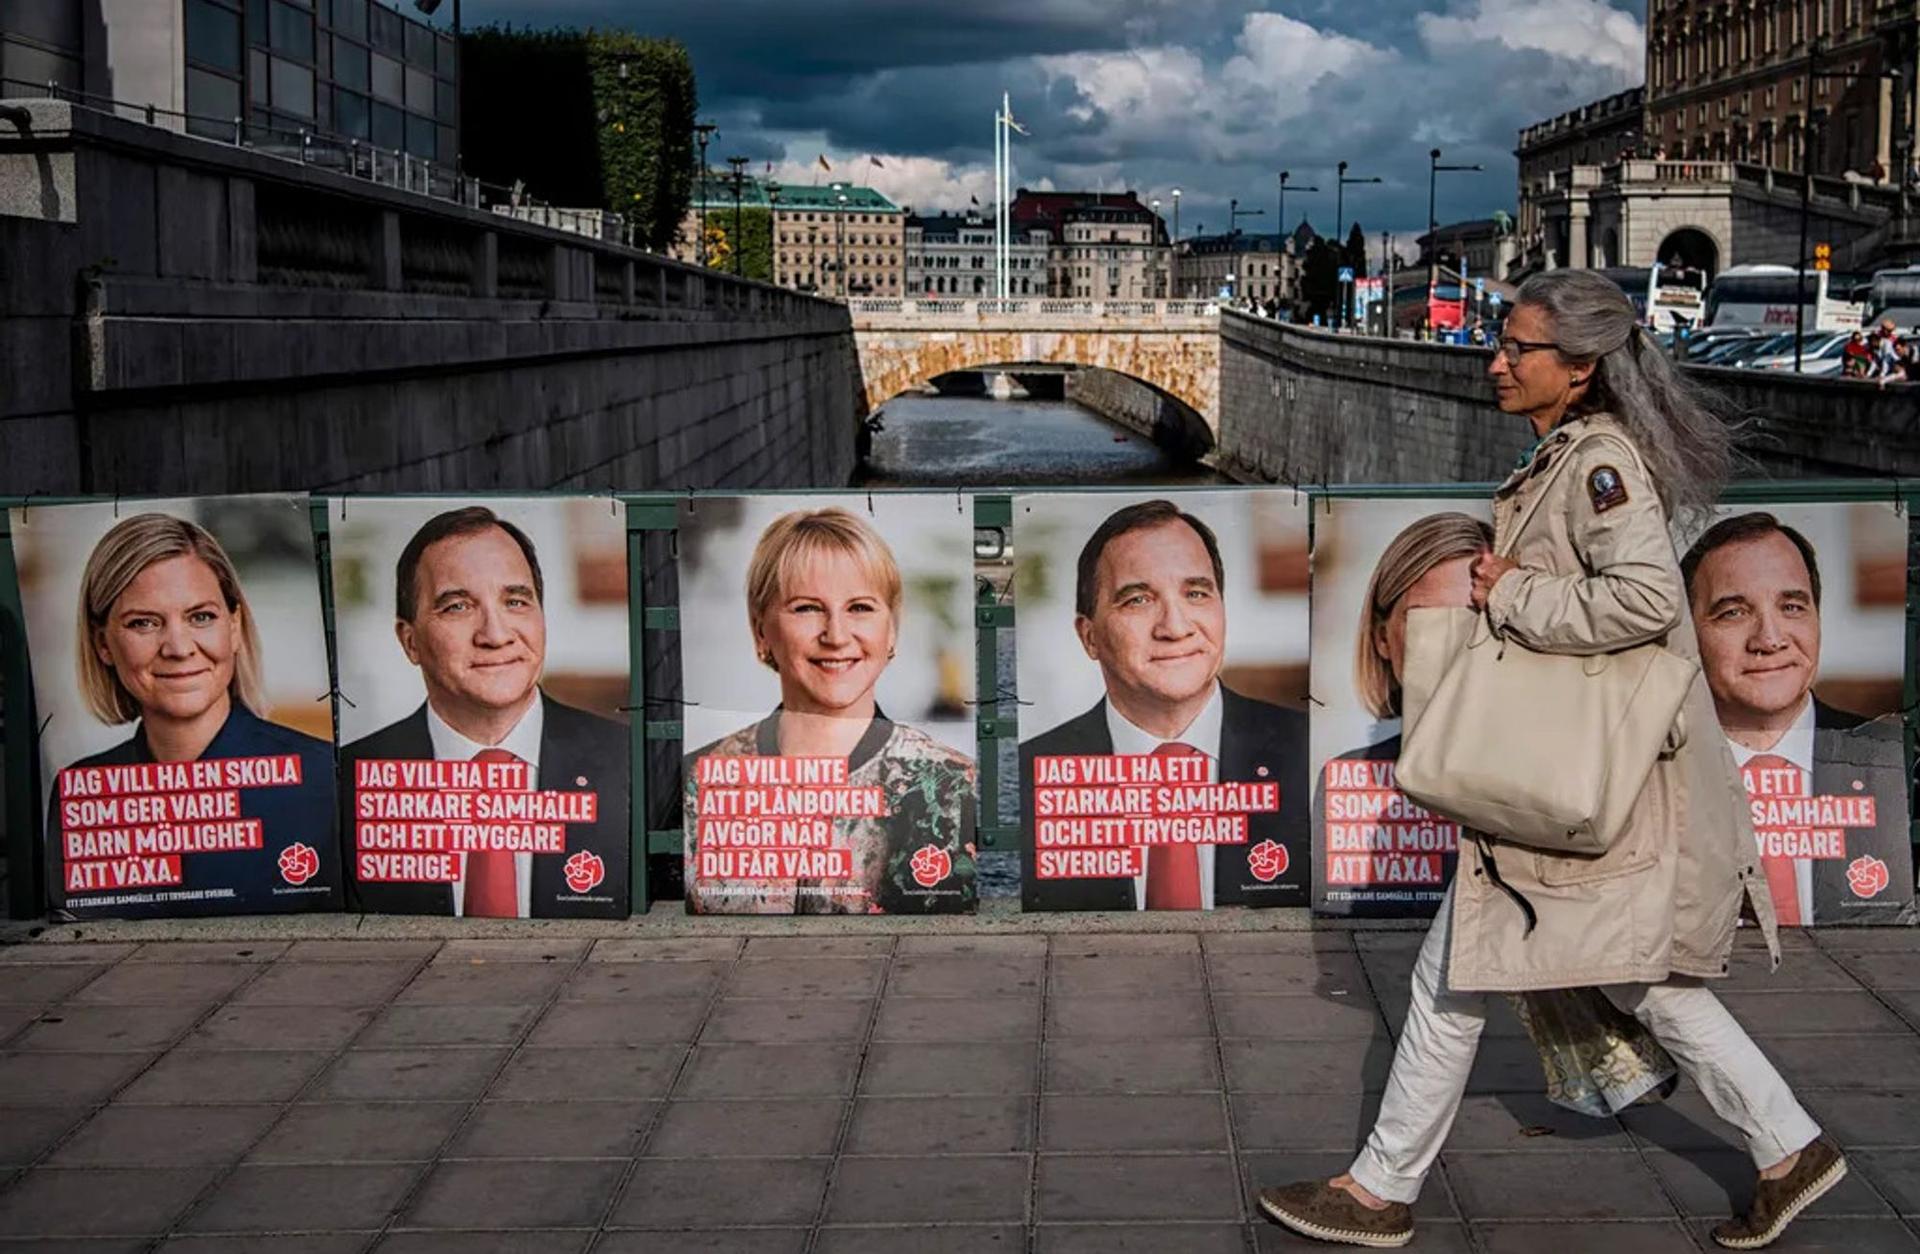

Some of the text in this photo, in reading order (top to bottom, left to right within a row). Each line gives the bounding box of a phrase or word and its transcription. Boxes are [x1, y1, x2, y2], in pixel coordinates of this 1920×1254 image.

[63, 757, 299, 796] JAG VILL HA EN SKOLA
[360, 762, 524, 789] JAG VILL HA ETT
[701, 758, 845, 784] JAG VILL INTE
[1037, 756, 1204, 784] JAG VILL HA ETT
[1330, 763, 1395, 788] JAG VI
[1743, 768, 1798, 794] A ETT
[66, 792, 237, 827] SOM GER VARJE
[360, 790, 592, 820] STARKARE SAMHÄLLE
[701, 785, 880, 815] ATT PLÅNBOKEN
[1039, 782, 1275, 815] STARKARE SAMHÄLLE
[1331, 794, 1382, 819] SOM
[1751, 795, 1870, 826] SAMHÄLLE
[68, 822, 258, 858] BARN MÖJLIGHET
[360, 823, 561, 850] OCH ETT TRYGGARE
[701, 817, 828, 846] AVGÖR NÄR
[1039, 816, 1244, 845] OCH ETT TRYGGARE
[1331, 826, 1392, 850] BARN
[1754, 832, 1841, 857] YGGARE
[70, 856, 180, 889] ATT VÄXA.
[361, 854, 459, 880] SVERIGE.
[702, 849, 849, 877] DU FÅR VÅRD.
[1040, 849, 1140, 876] SVERIGE.
[1332, 853, 1440, 882] ATT VÄXA.
